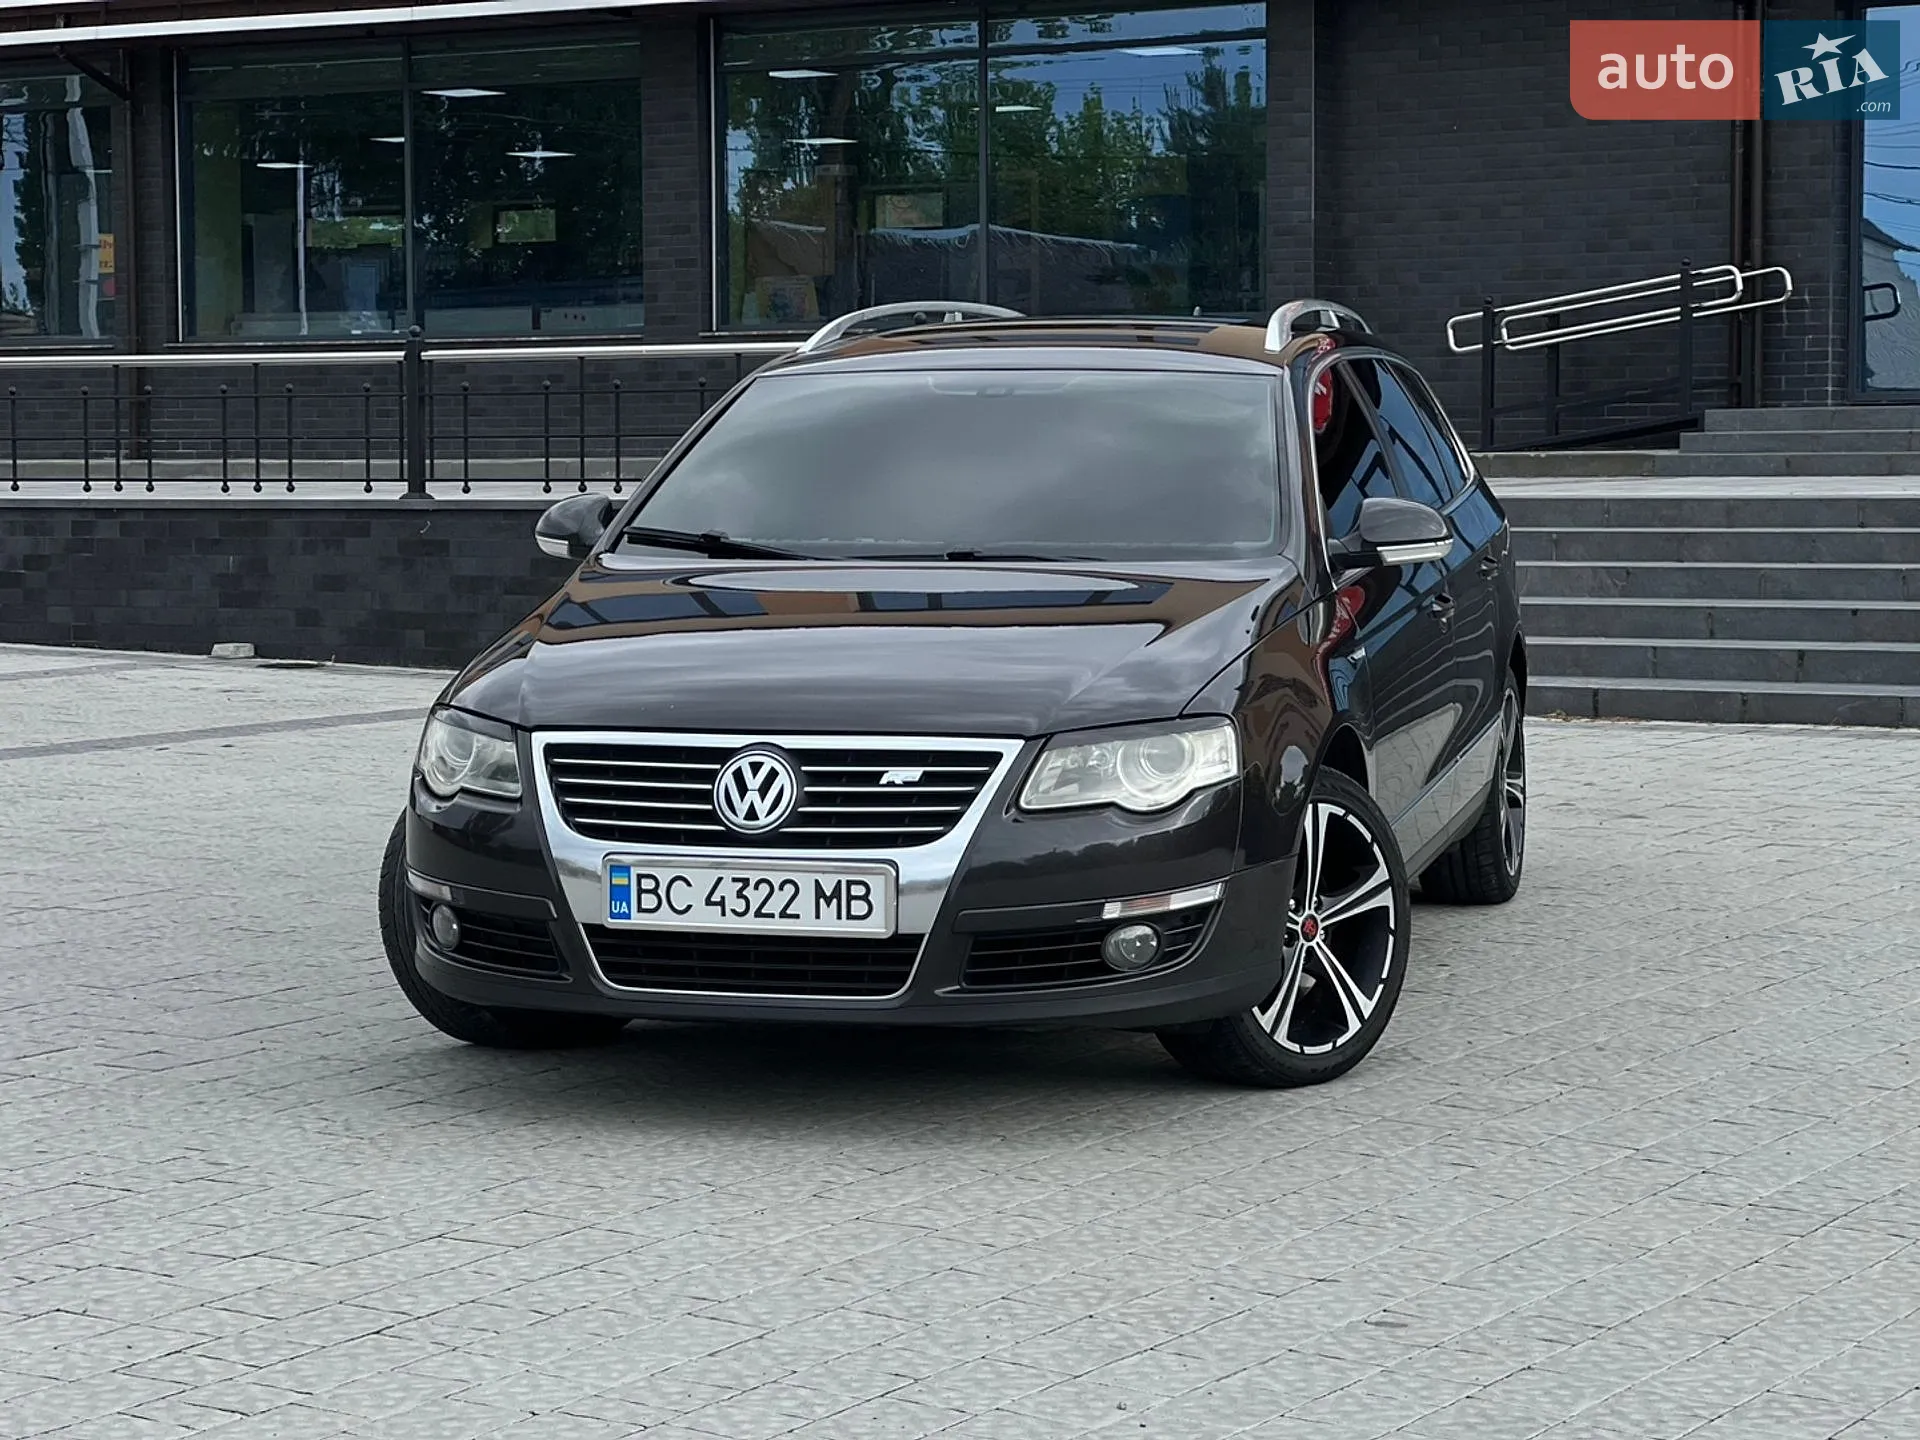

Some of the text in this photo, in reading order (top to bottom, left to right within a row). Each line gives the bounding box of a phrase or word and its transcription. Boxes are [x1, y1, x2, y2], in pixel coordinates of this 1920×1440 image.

[716, 752, 796, 832] VW
[611, 900, 629, 914] UA
[635, 873, 874, 920] BC 4322 MB
